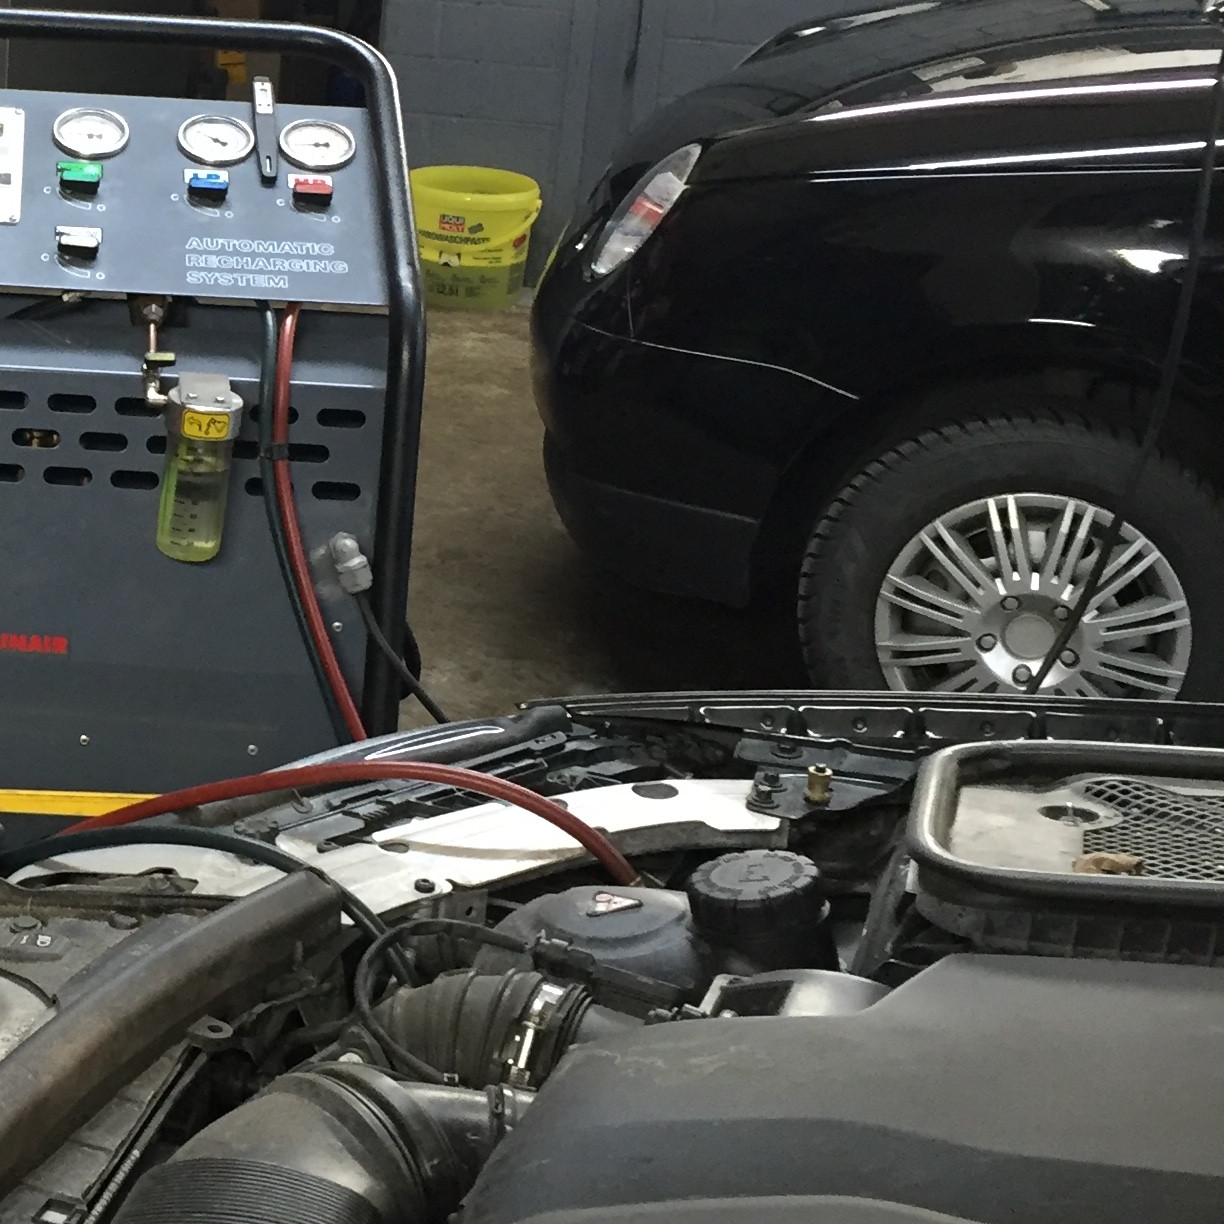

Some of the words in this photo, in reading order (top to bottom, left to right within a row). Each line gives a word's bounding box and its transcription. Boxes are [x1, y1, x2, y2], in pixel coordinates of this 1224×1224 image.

[185, 236, 335, 257] AUTOMATIC
[185, 253, 349, 274] RECHARGING
[186, 270, 289, 288] SYSTEM
